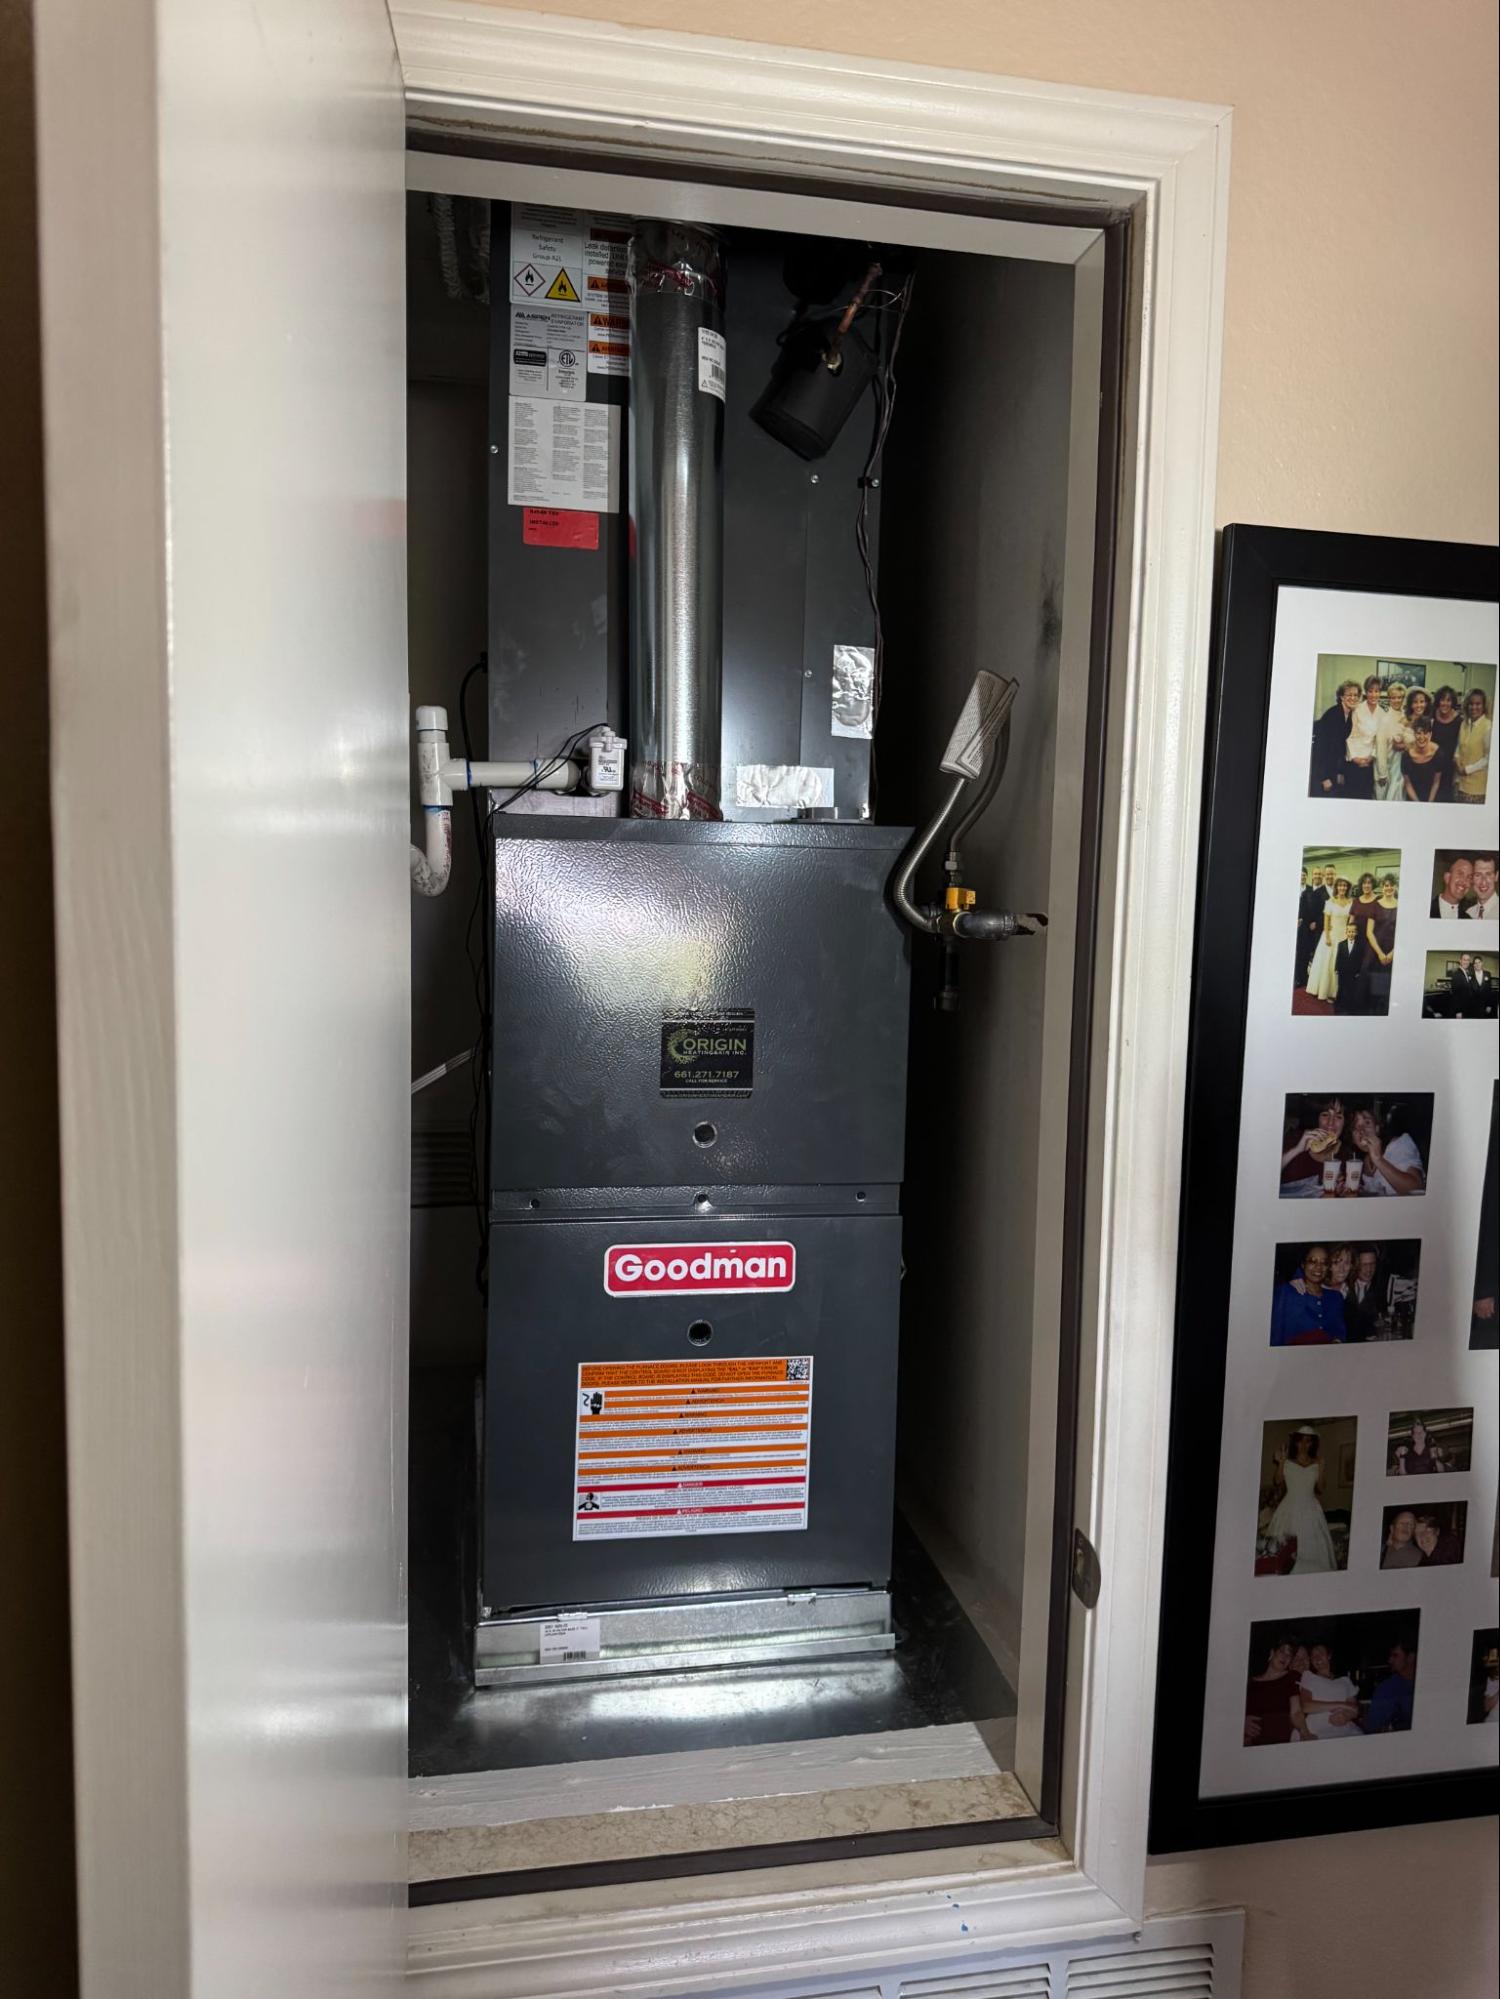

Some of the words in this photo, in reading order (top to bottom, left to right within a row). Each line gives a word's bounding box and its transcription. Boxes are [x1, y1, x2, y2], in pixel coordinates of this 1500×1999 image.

[683, 1038, 747, 1051] ORIGIN
[674, 1070, 740, 1079] 661.271.7187
[614, 1252, 787, 1282] Goodman
